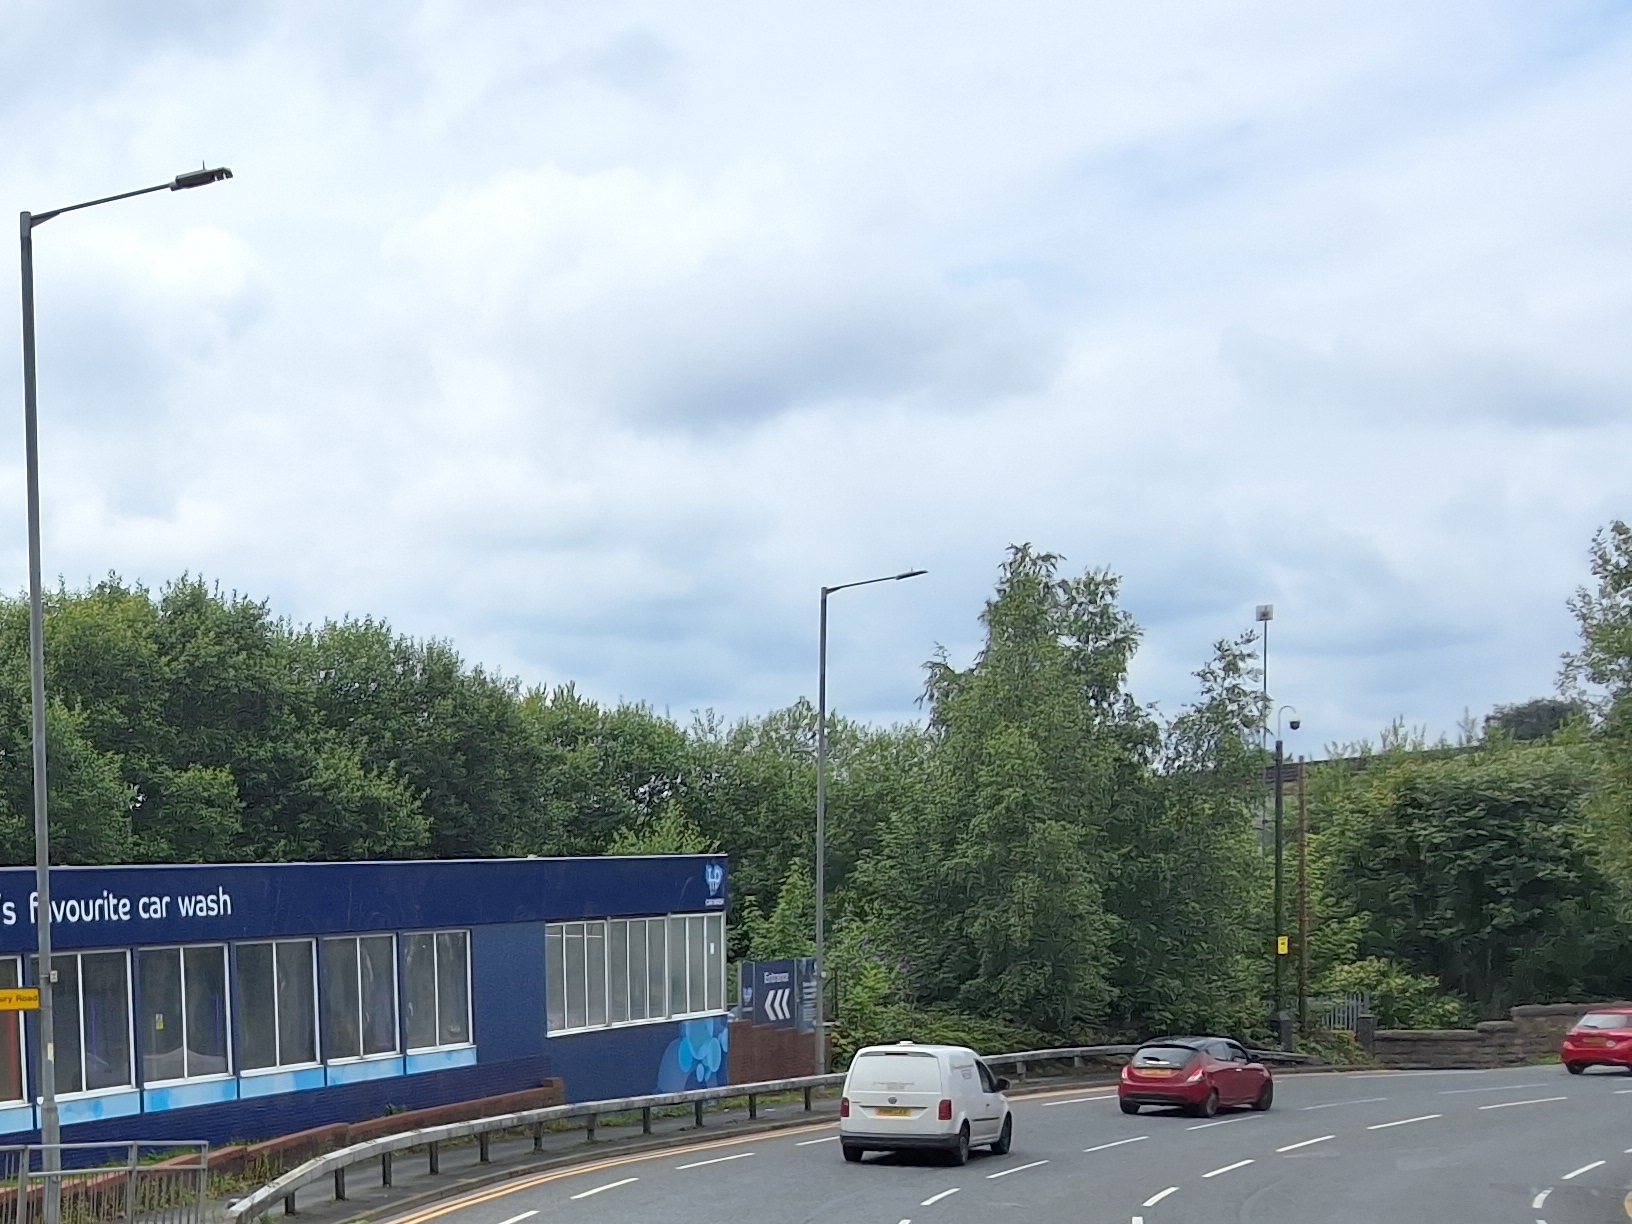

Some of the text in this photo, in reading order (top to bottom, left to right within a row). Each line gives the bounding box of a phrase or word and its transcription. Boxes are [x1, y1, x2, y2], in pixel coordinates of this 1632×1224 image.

[29, 889, 131, 924] fvourite
[138, 895, 170, 919] car
[177, 886, 232, 917] wash
[16, 994, 38, 1002] Road
